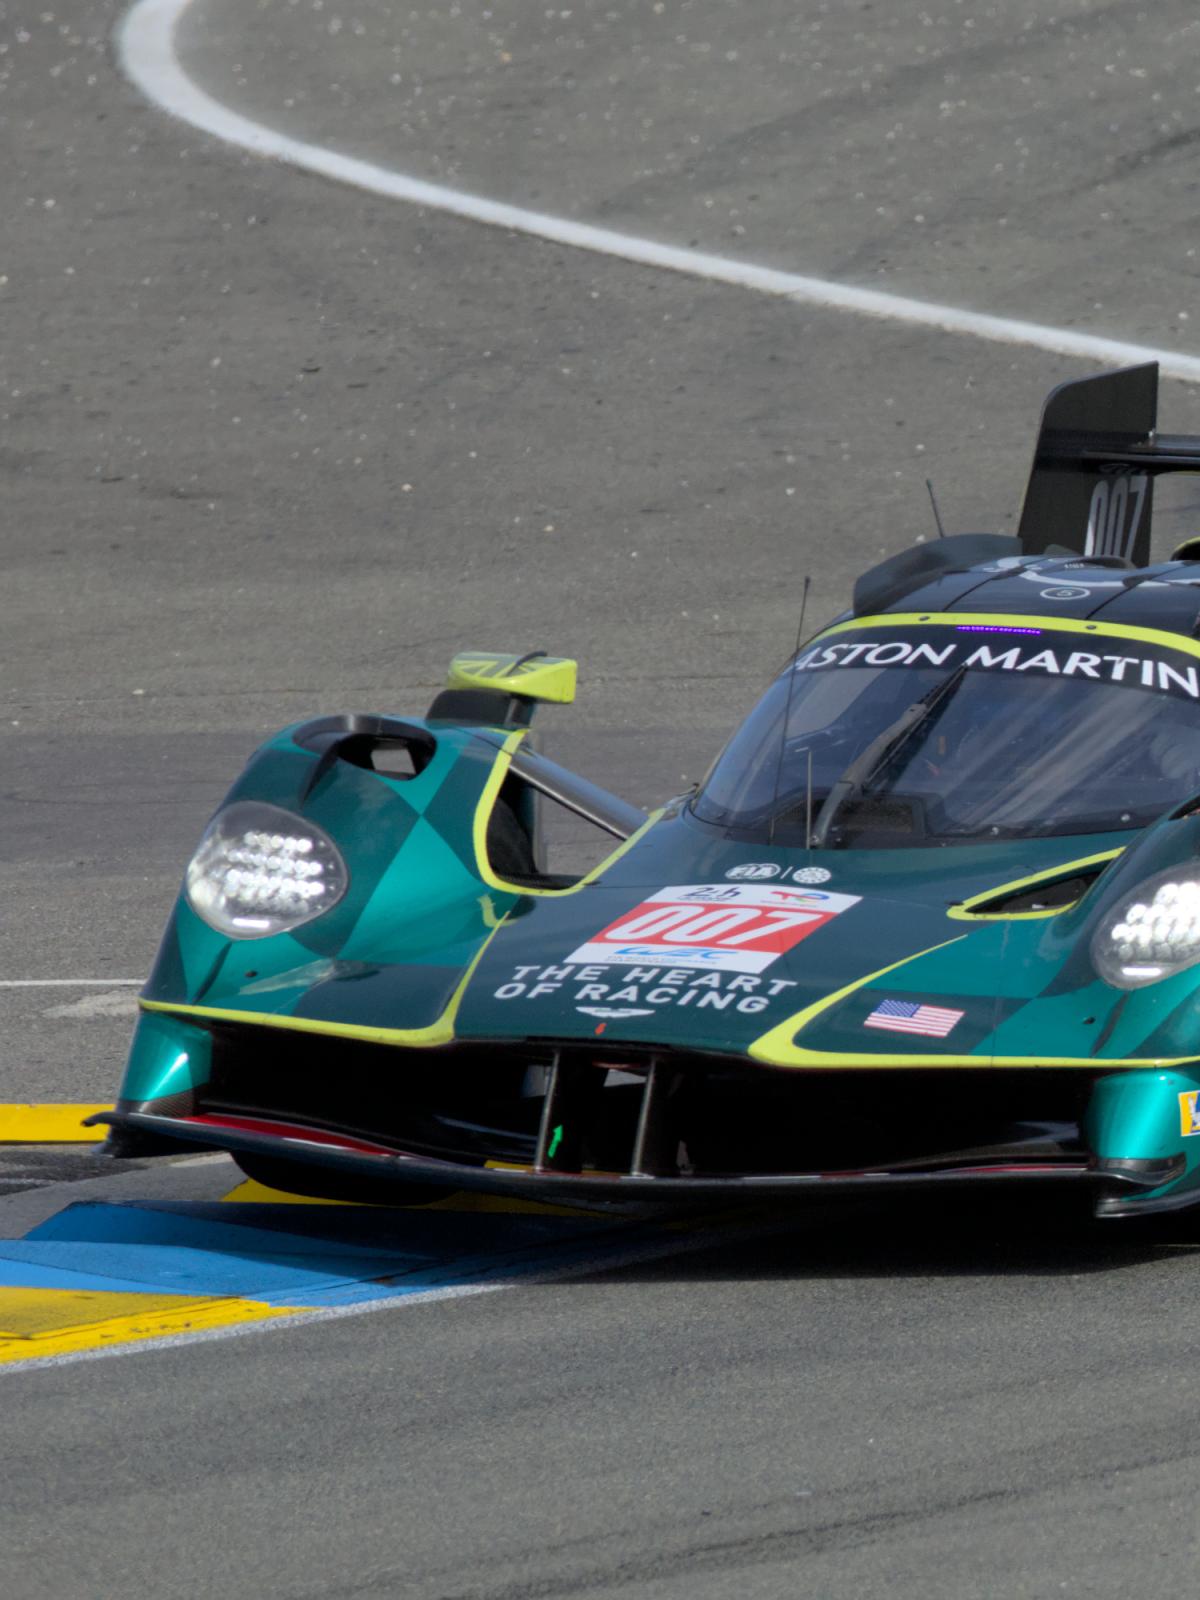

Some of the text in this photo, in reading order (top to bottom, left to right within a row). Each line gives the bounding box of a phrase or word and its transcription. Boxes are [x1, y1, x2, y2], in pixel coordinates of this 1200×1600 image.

[964, 646, 1200, 698] MARTIN
[604, 905, 824, 945] 007
[493, 982, 770, 1013] OF RACING
[511, 965, 798, 995] THE HEART
